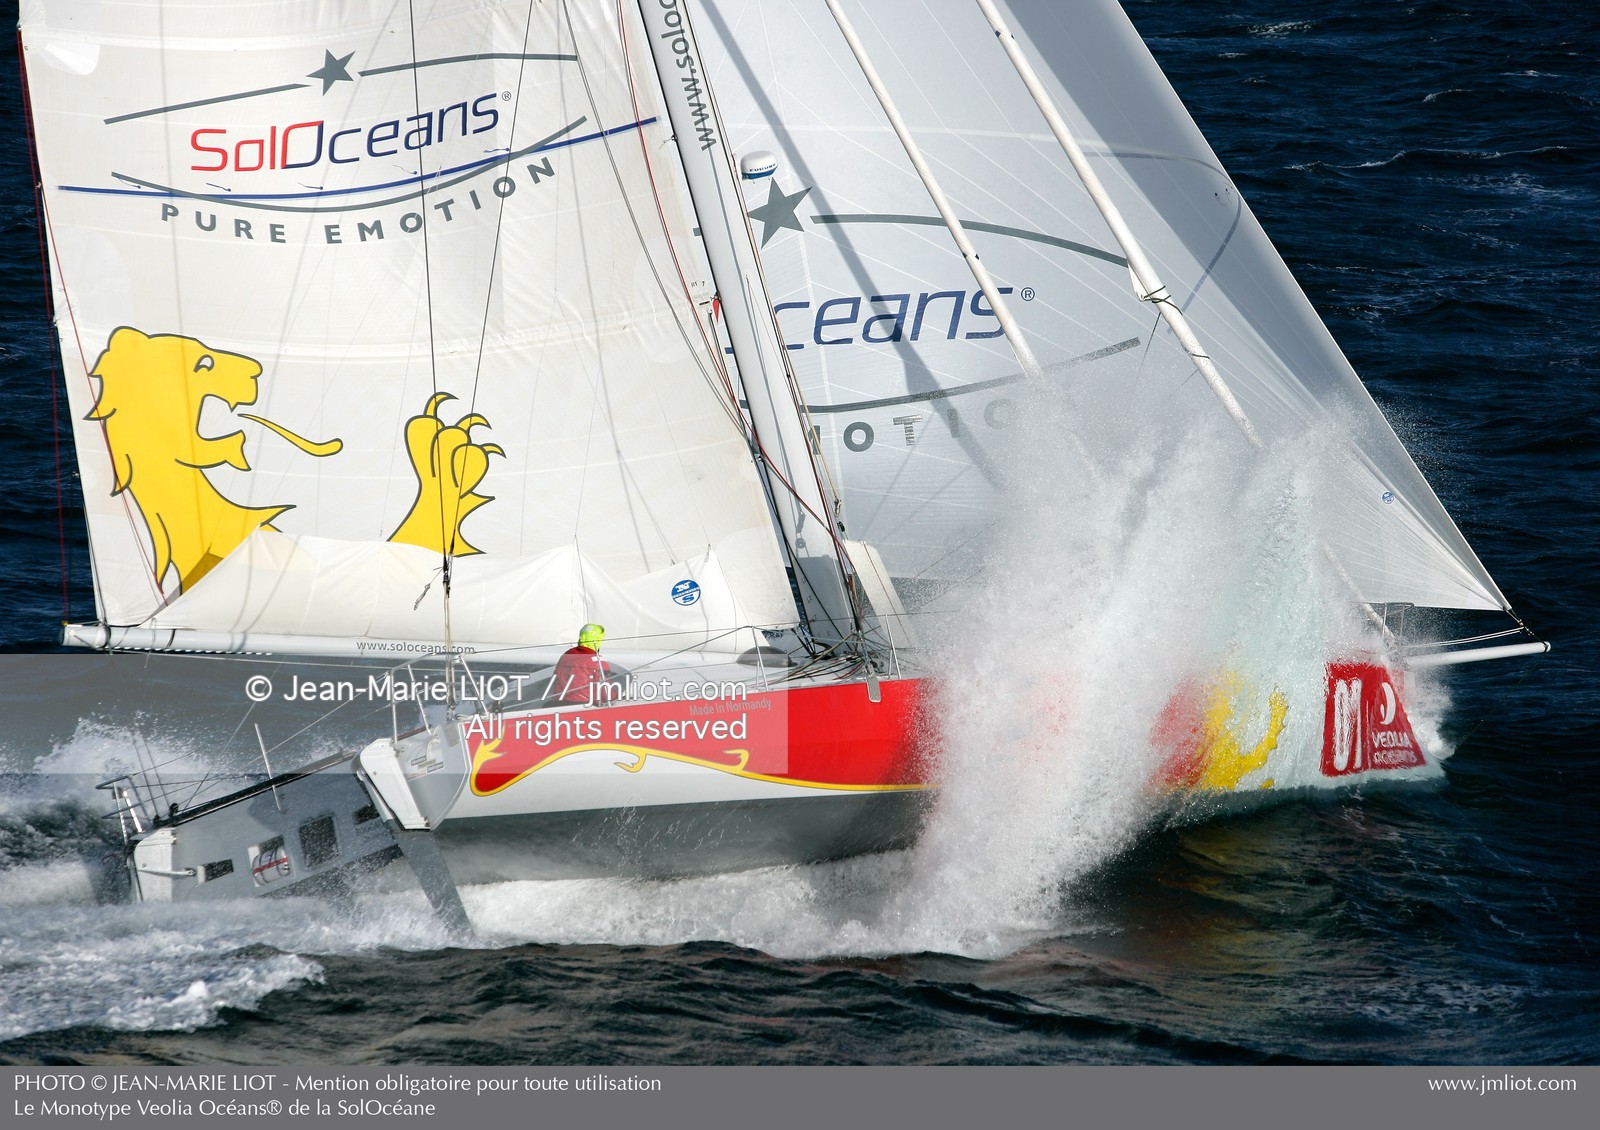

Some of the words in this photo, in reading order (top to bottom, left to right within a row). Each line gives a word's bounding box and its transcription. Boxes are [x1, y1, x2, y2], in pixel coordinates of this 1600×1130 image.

[161, 203, 287, 244] PURE
[324, 157, 556, 244] EMOTION
[356, 641, 475, 654] www.soloceanscom
[689, 703, 714, 717] Made
[726, 697, 771, 711] Normandy
